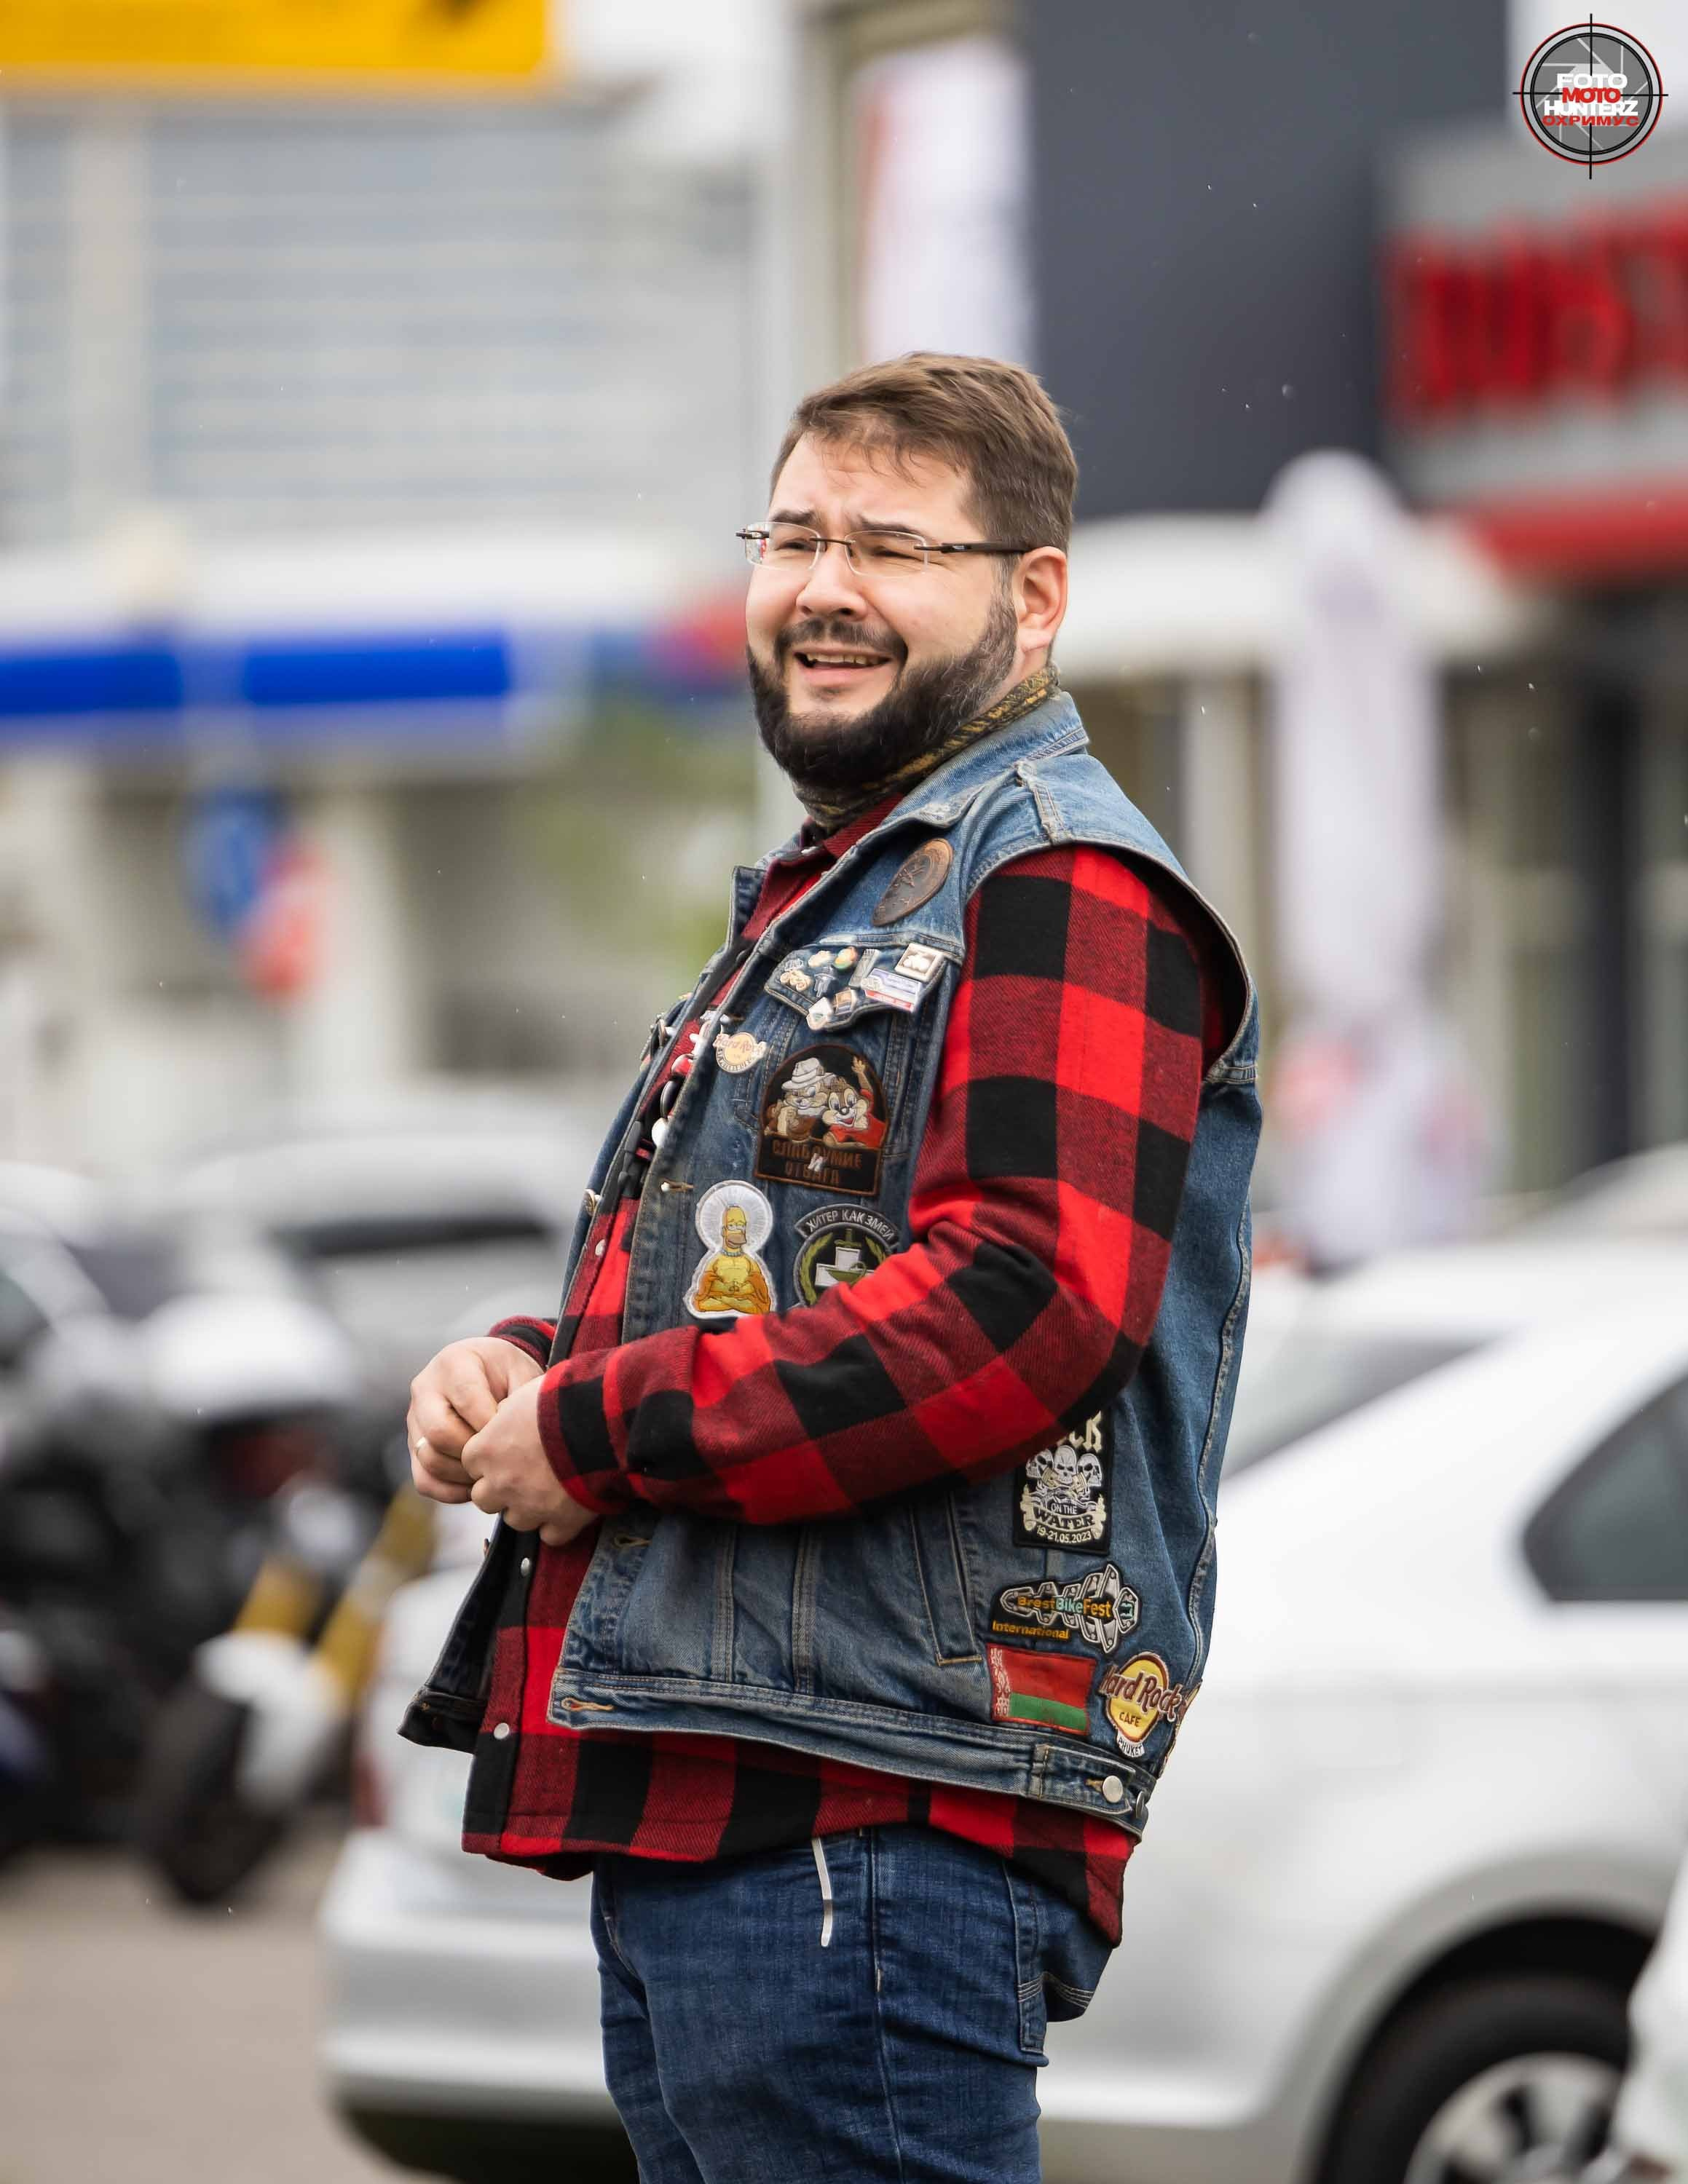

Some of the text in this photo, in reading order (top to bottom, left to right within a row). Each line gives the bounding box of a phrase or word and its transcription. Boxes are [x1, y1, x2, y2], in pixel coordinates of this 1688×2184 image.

[805, 1210, 838, 1233] ХИТЕР
[842, 1209, 865, 1224] КАК
[1033, 1506, 1095, 1529] WATER
[1051, 1503, 1078, 1515] ON THE
[1036, 1524, 1092, 1543] 19-21.05.2023
[992, 1620, 1069, 1639] International
[1099, 1664, 1183, 1722] Hard Rock
[1119, 1712, 1142, 1728] CAFE
[1118, 1737, 1144, 1757] PHUKET
